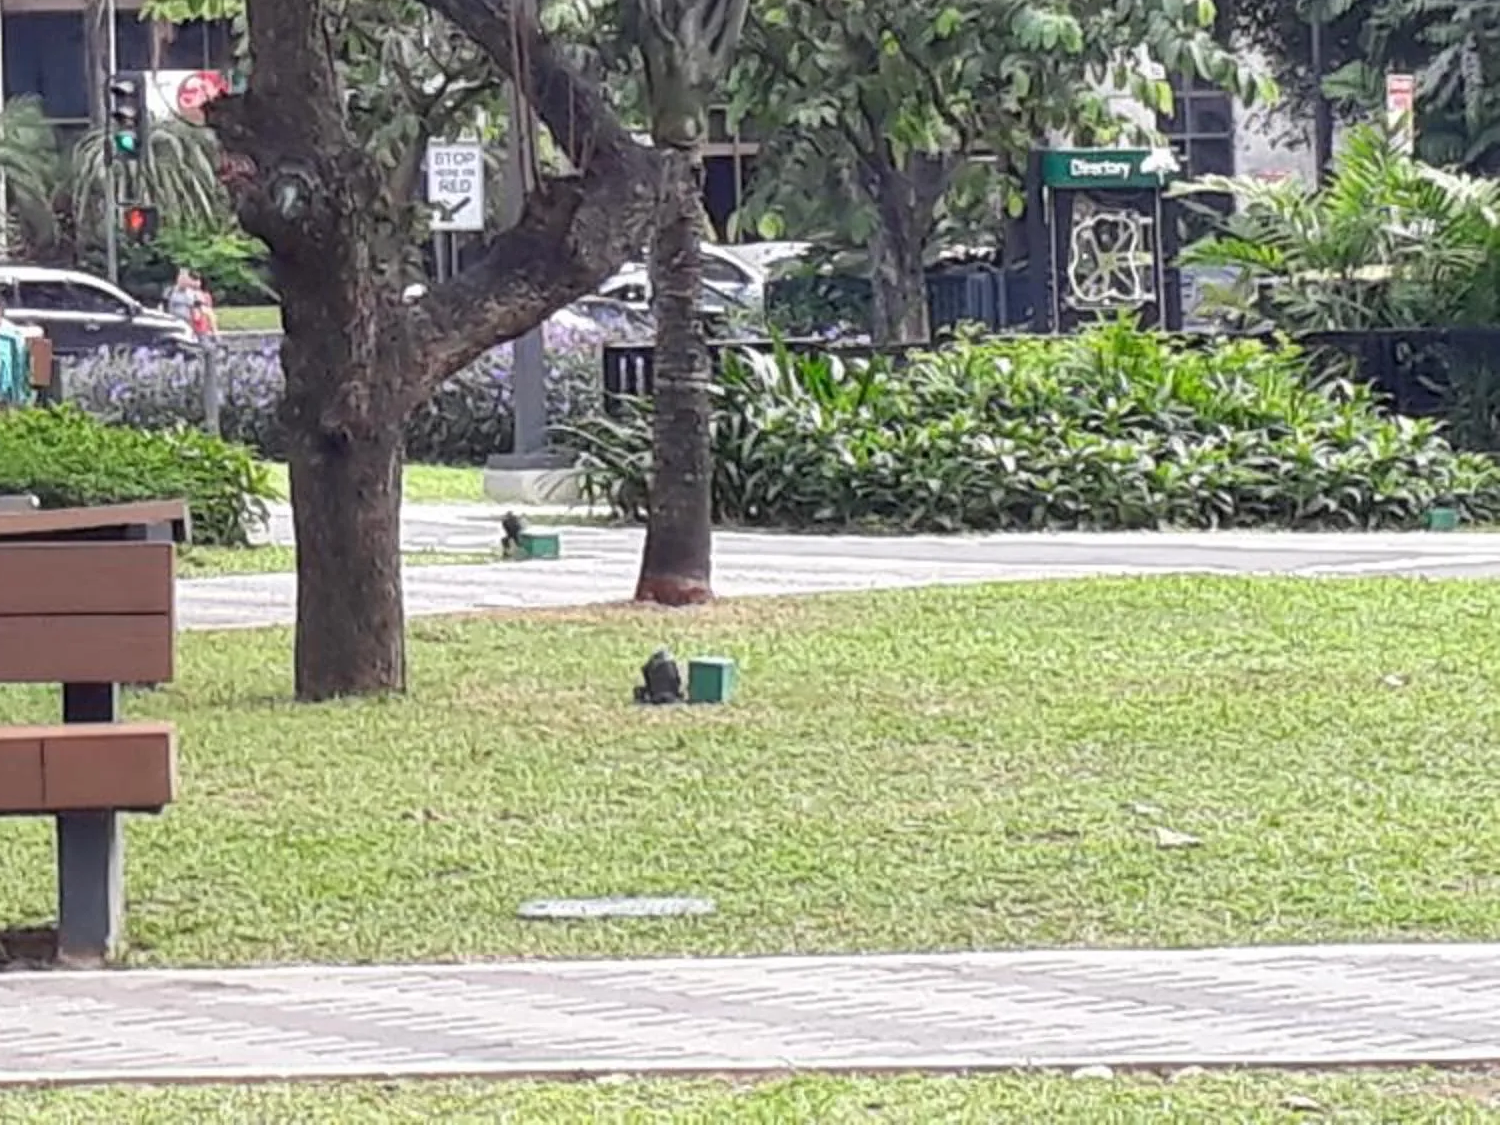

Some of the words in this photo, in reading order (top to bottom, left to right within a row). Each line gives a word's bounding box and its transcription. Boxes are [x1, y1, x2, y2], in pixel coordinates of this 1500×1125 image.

[435, 152, 476, 165] STOP
[1069, 159, 1131, 179] Directory
[438, 179, 472, 193] RED
